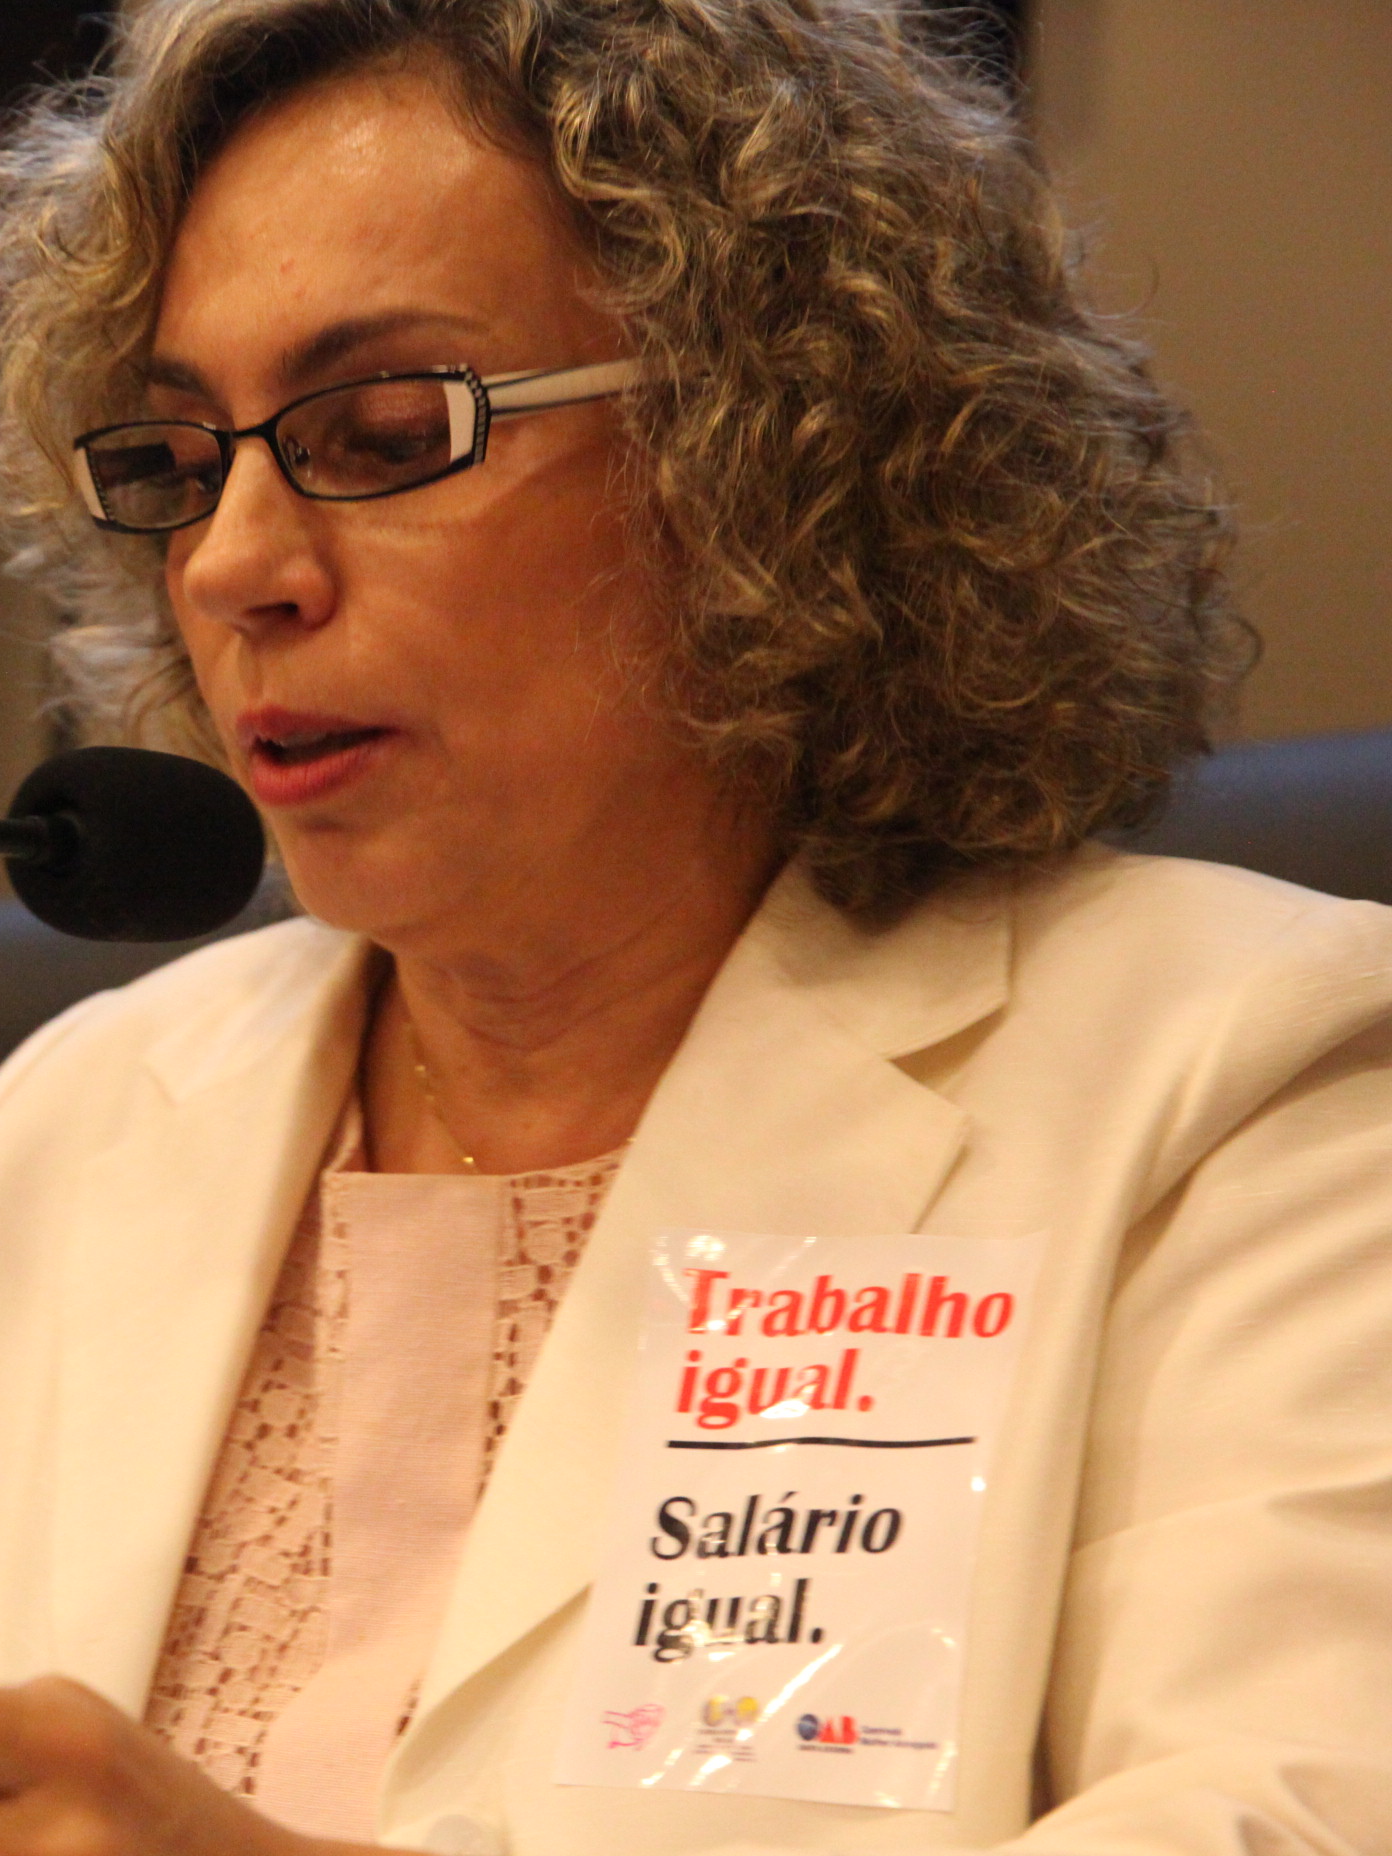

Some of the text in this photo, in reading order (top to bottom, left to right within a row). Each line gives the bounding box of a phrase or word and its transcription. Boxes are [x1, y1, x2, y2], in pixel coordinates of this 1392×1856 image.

[684, 1267, 1015, 1339] Trabalho
[674, 1347, 875, 1430] igual.
[650, 1490, 902, 1560] Salário
[633, 1577, 824, 1664] igual.
